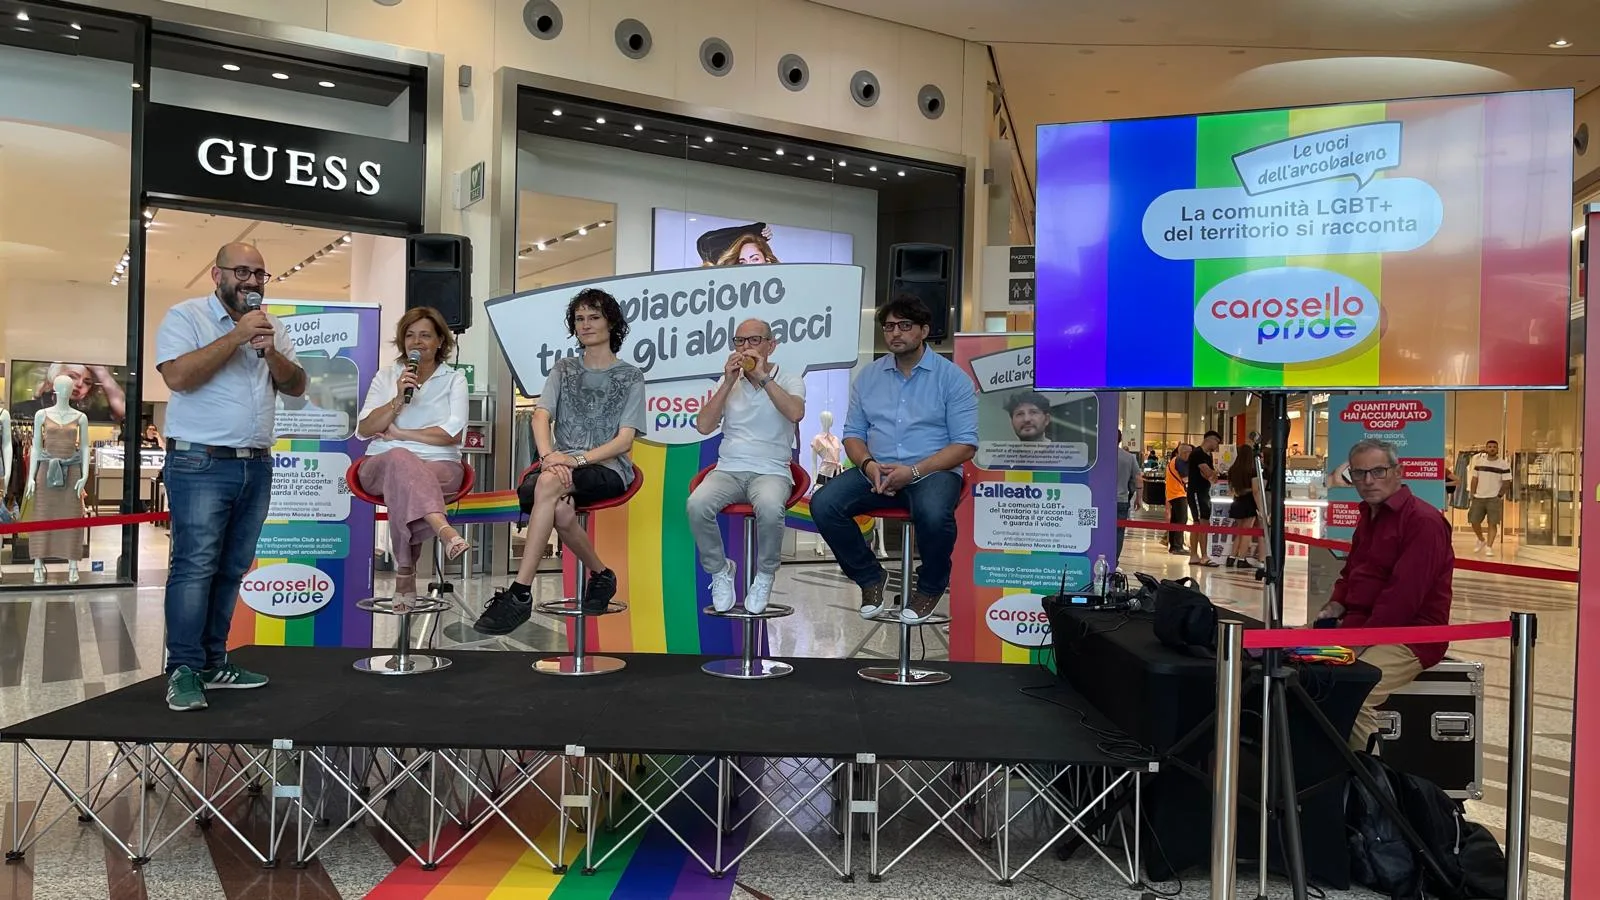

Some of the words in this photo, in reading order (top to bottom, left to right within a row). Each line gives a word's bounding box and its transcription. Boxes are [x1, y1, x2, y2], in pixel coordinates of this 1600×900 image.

[1293, 144, 1312, 159] Le
[1315, 134, 1349, 153] voci
[198, 137, 381, 195] GUESS
[1258, 147, 1387, 185] dell'arcobaleno
[1181, 206, 1205, 221] La
[1212, 199, 1309, 220] comunità
[1317, 196, 1393, 215] LGBT+
[1164, 226, 1193, 241] del
[1200, 221, 1289, 240] territorio
[1296, 221, 1314, 236] si
[1321, 217, 1418, 236] racconta
[1211, 286, 1364, 319] carosello
[294, 318, 321, 333] voci
[1258, 316, 1357, 345] pride
[291, 331, 348, 347] cobaleno
[633, 327, 678, 373] gli
[1016, 354, 1031, 366] Le
[1353, 403, 1388, 411] QUANTI
[1389, 402, 1417, 410] PUNTI
[1343, 412, 1359, 420] HAI
[1360, 411, 1427, 420] ACCUMULATO
[1369, 420, 1399, 429] OGGI?
[972, 483, 1043, 499] L'alleato
[999, 513, 1030, 521] inquadra
[243, 574, 329, 592] carosello
[272, 589, 324, 606] pride
[989, 609, 1048, 623] carose
